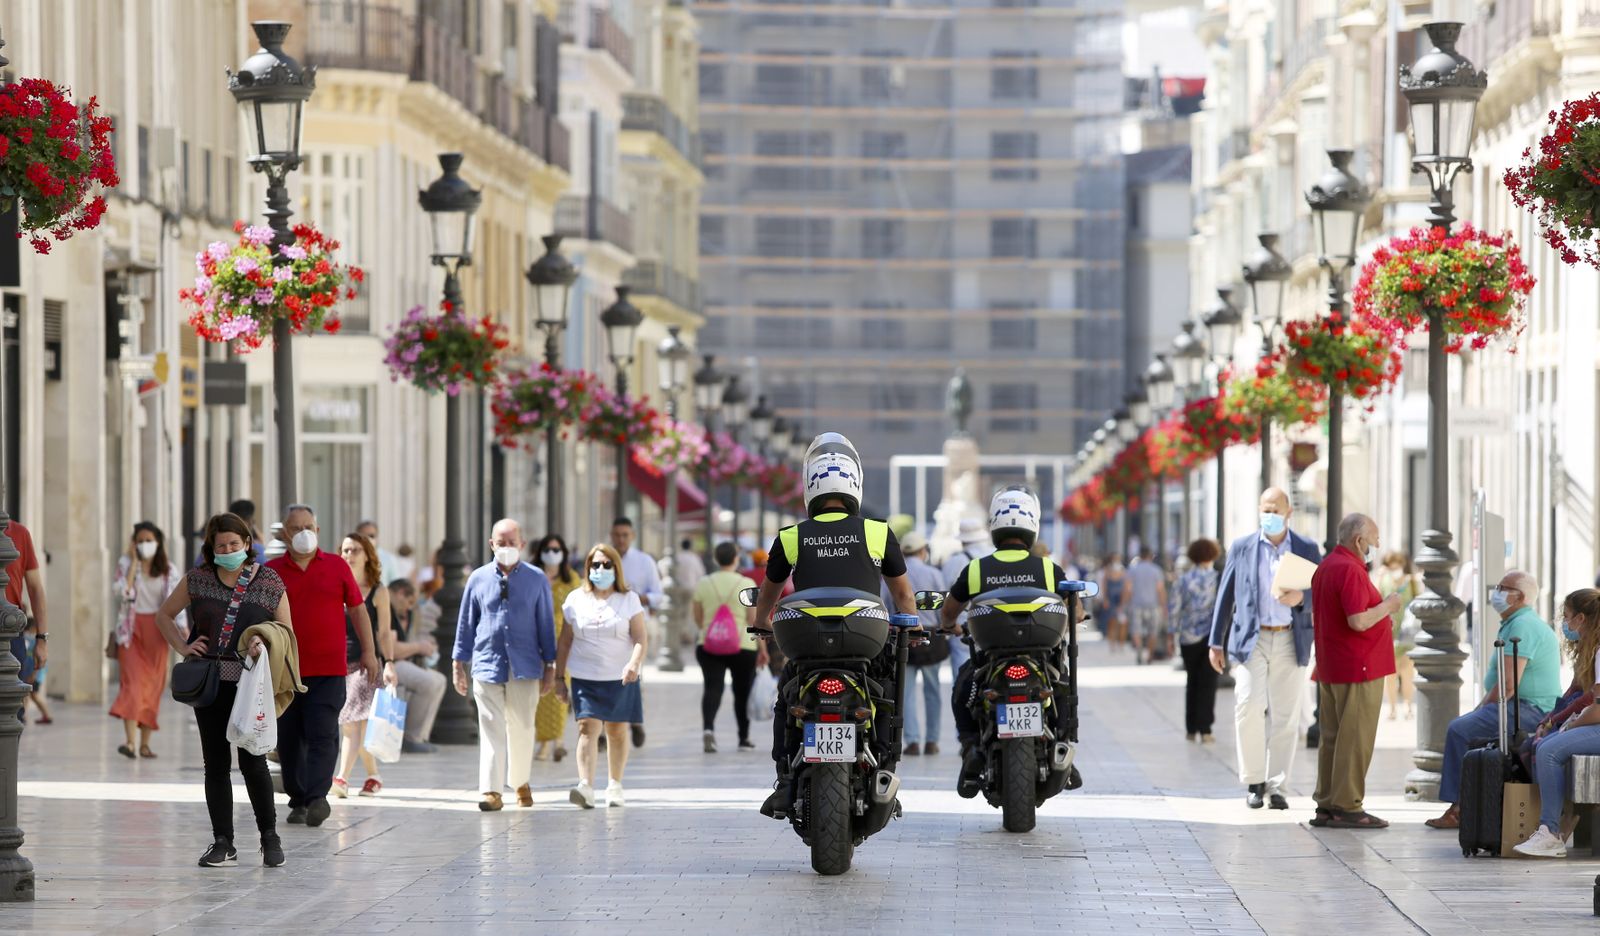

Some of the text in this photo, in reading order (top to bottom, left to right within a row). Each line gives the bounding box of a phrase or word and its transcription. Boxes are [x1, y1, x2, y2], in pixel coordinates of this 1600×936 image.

[803, 534, 860, 546] POLICÍA LOCAL
[817, 547, 850, 558] MÁLAGA
[986, 573, 1036, 584] POLICÍA LOCAL
[1009, 706, 1038, 718] 1132
[1008, 719, 1032, 730] KKR
[819, 727, 852, 740] 1134
[817, 741, 844, 754] KKR
